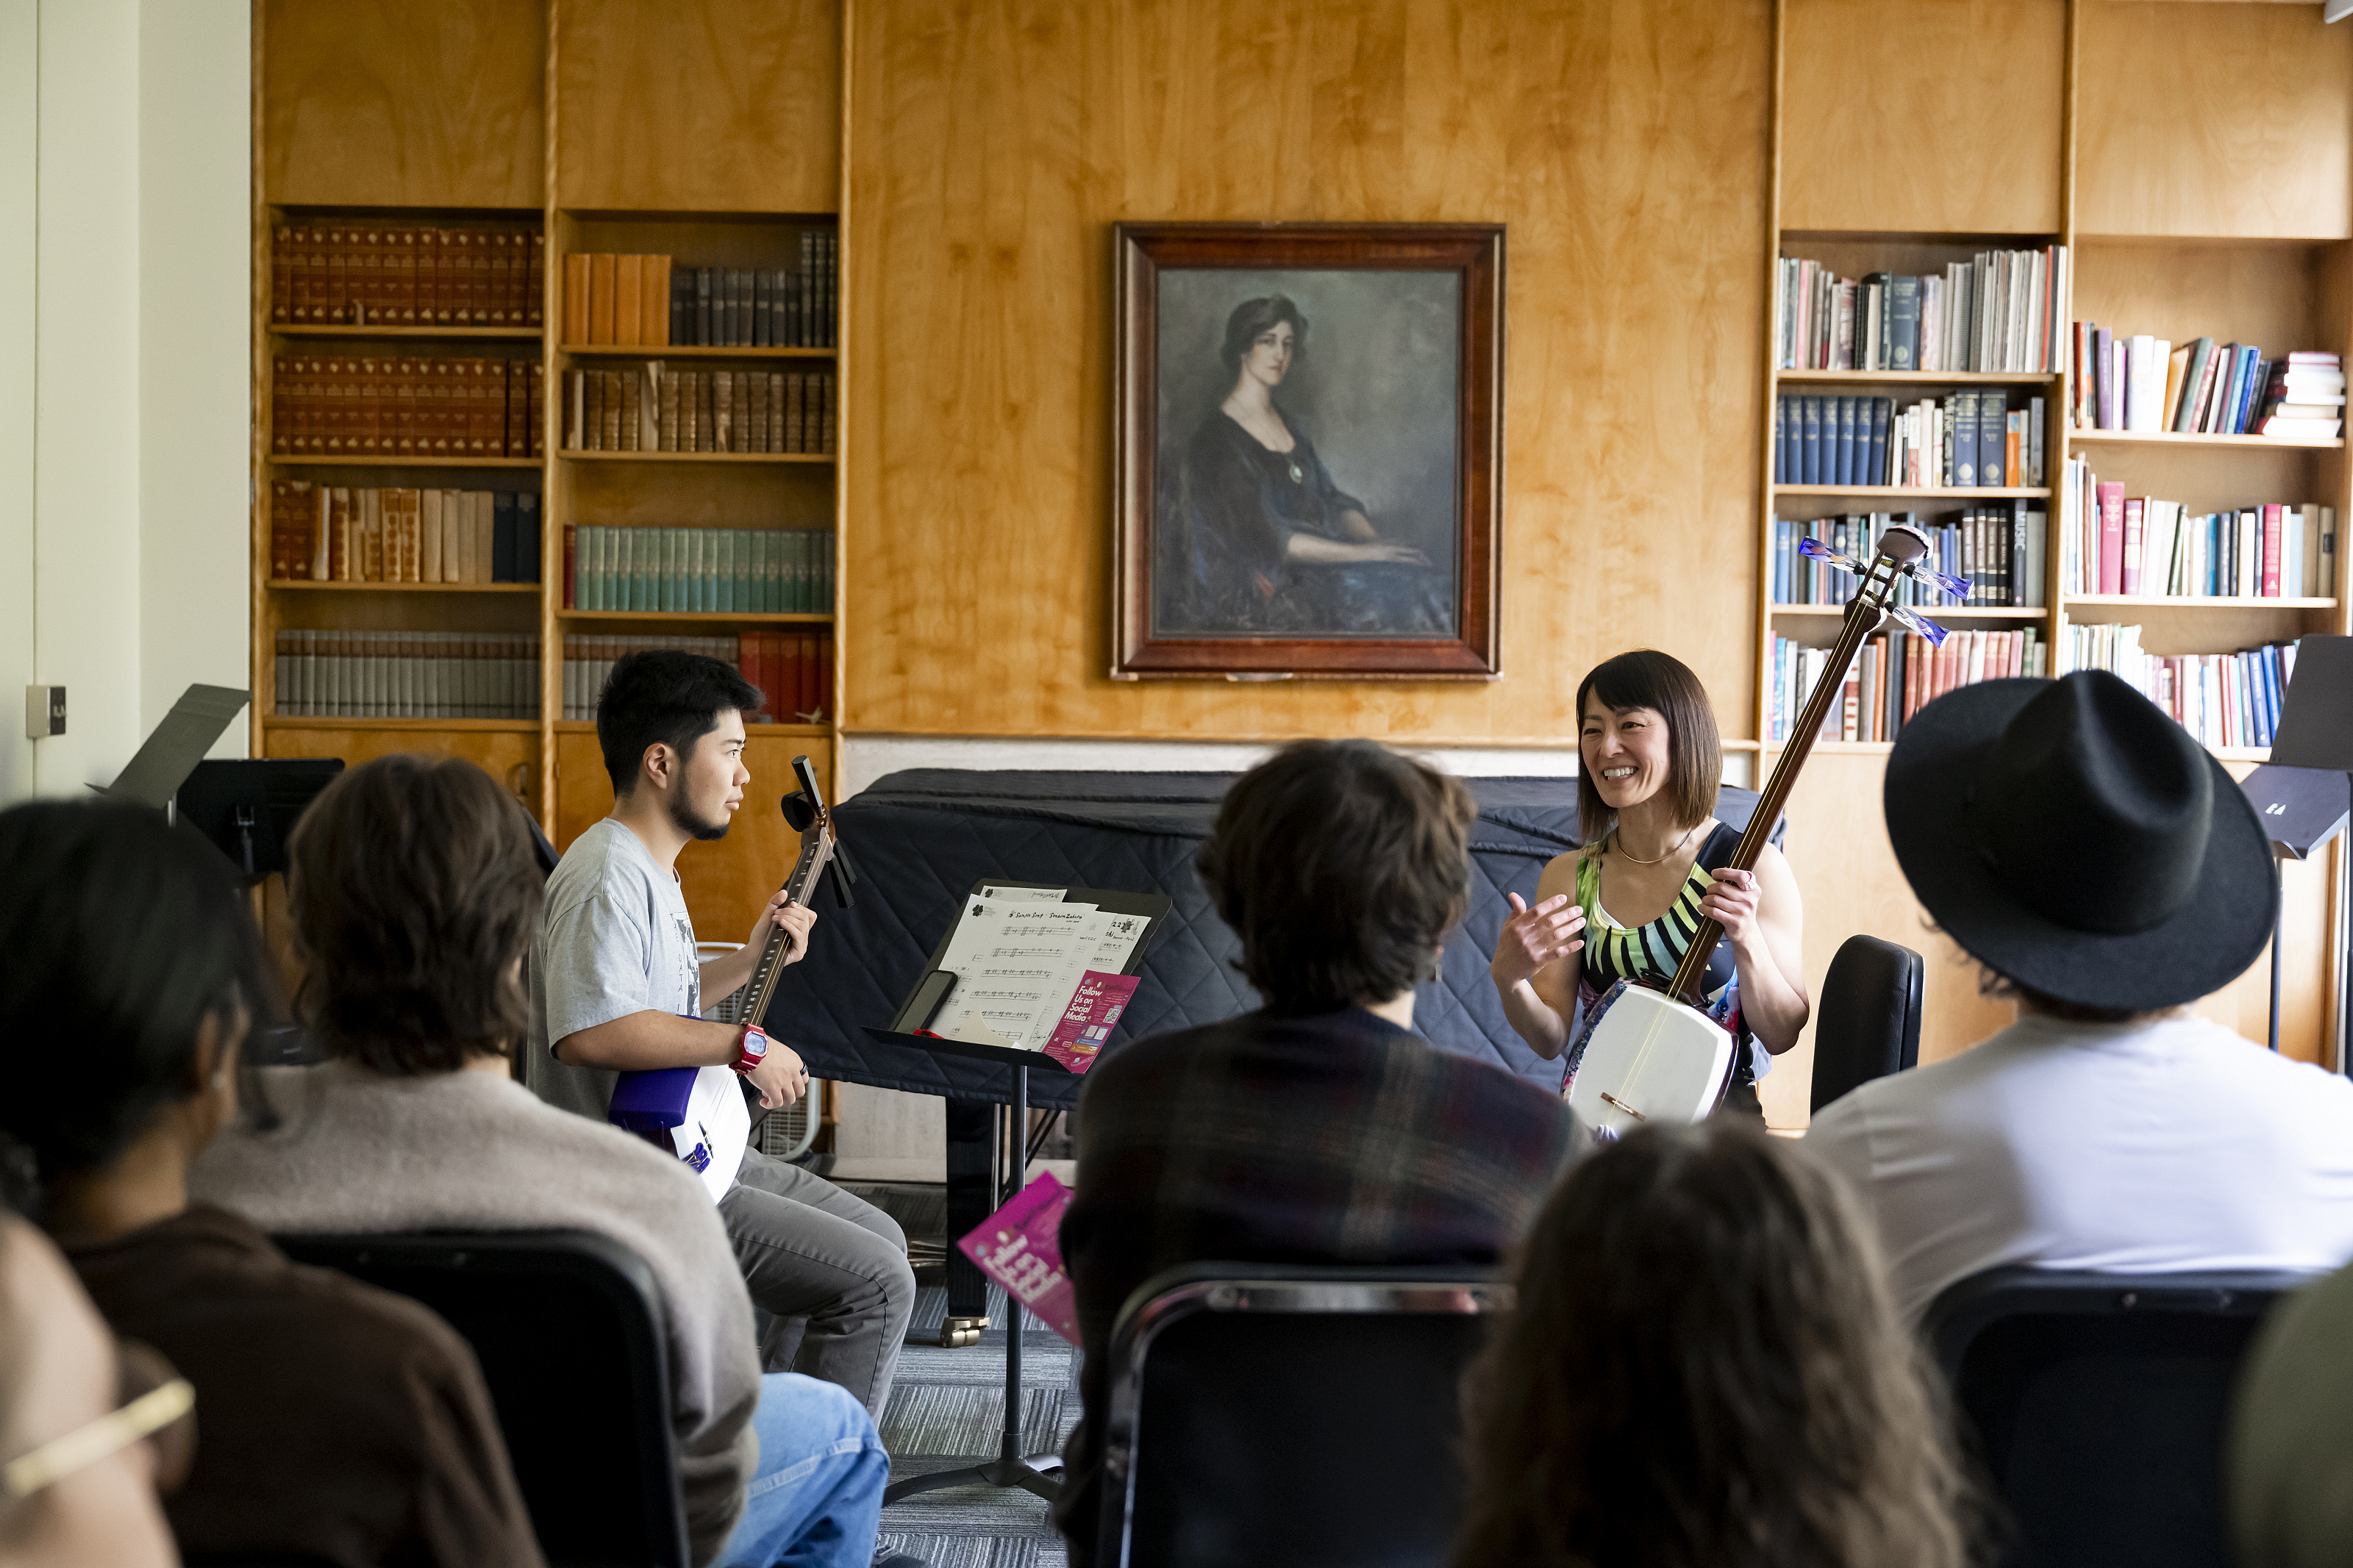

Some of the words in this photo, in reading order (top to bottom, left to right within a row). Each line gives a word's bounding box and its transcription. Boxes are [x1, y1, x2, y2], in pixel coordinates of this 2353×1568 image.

[2015, 510, 2026, 551] MUSIC
[1078, 985, 1103, 997] Follow
[1074, 994, 1085, 1003] Us
[1069, 1002, 1093, 1013] Social
[1064, 1011, 1087, 1022] Media
